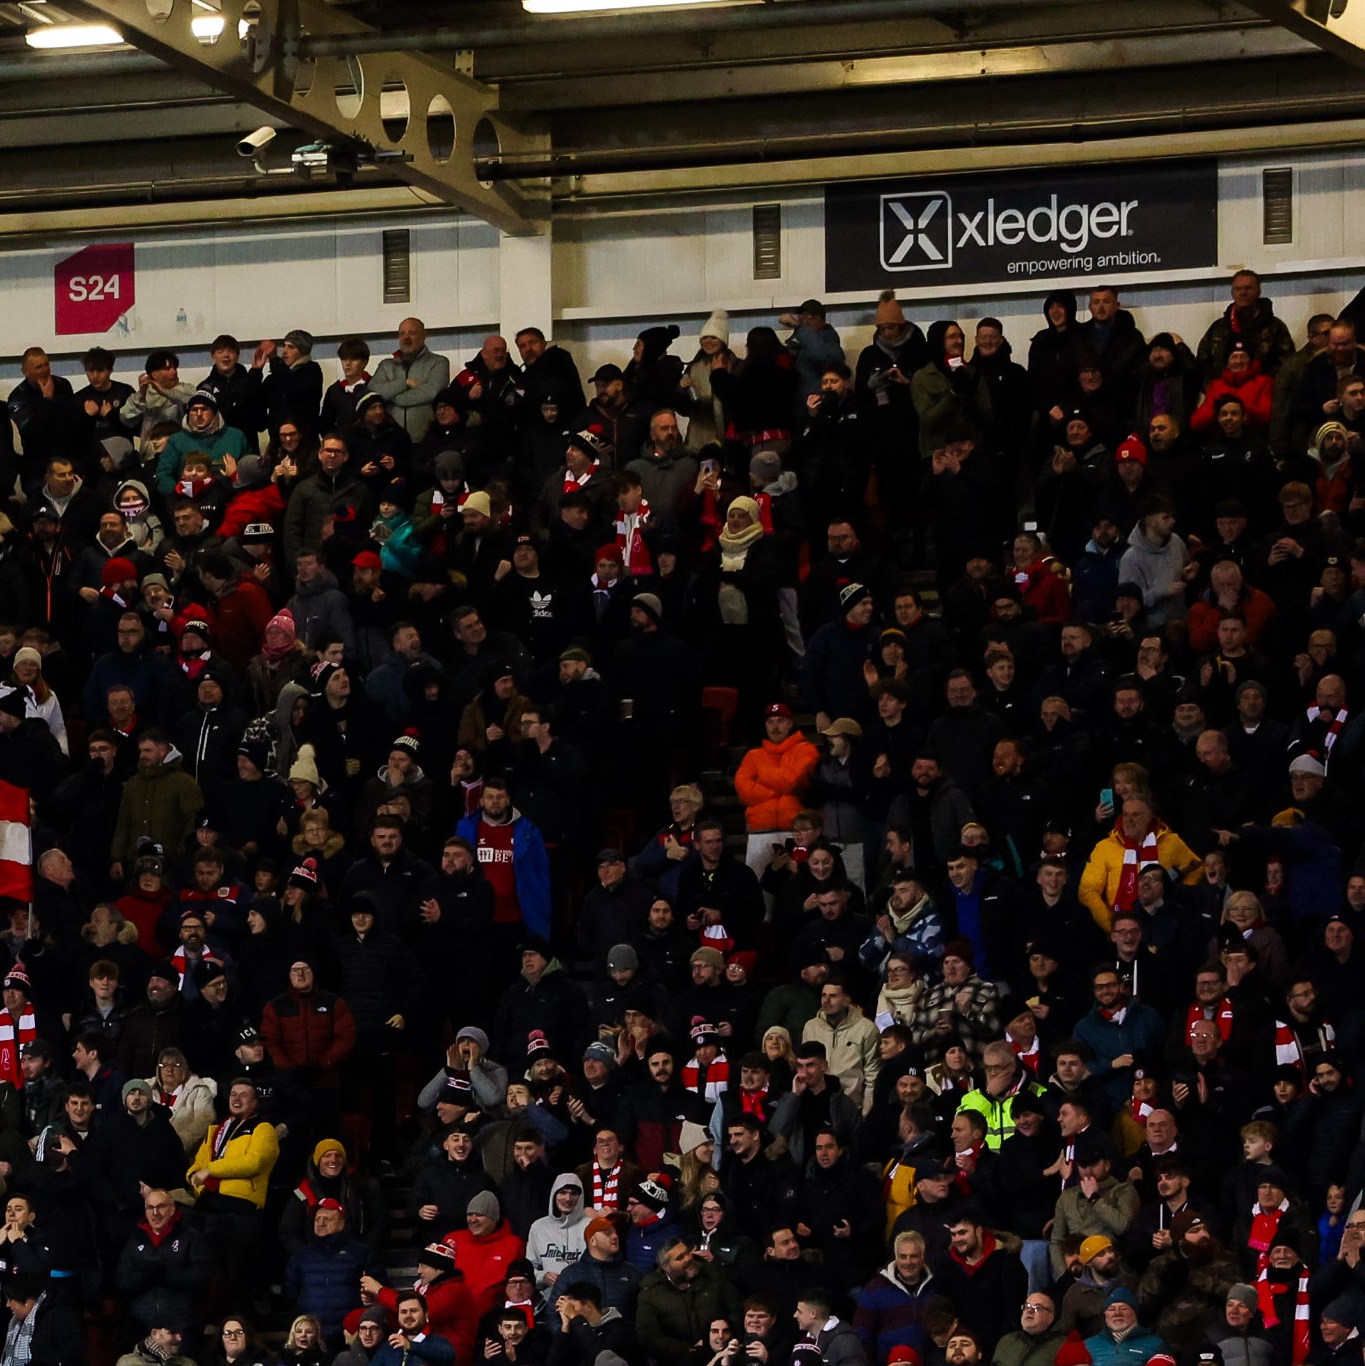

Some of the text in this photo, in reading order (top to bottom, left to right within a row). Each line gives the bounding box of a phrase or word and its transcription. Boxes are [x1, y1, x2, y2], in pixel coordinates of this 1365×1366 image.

[955, 193, 1139, 253] xledger
[1006, 258, 1095, 276] empowering
[68, 274, 121, 303] S24
